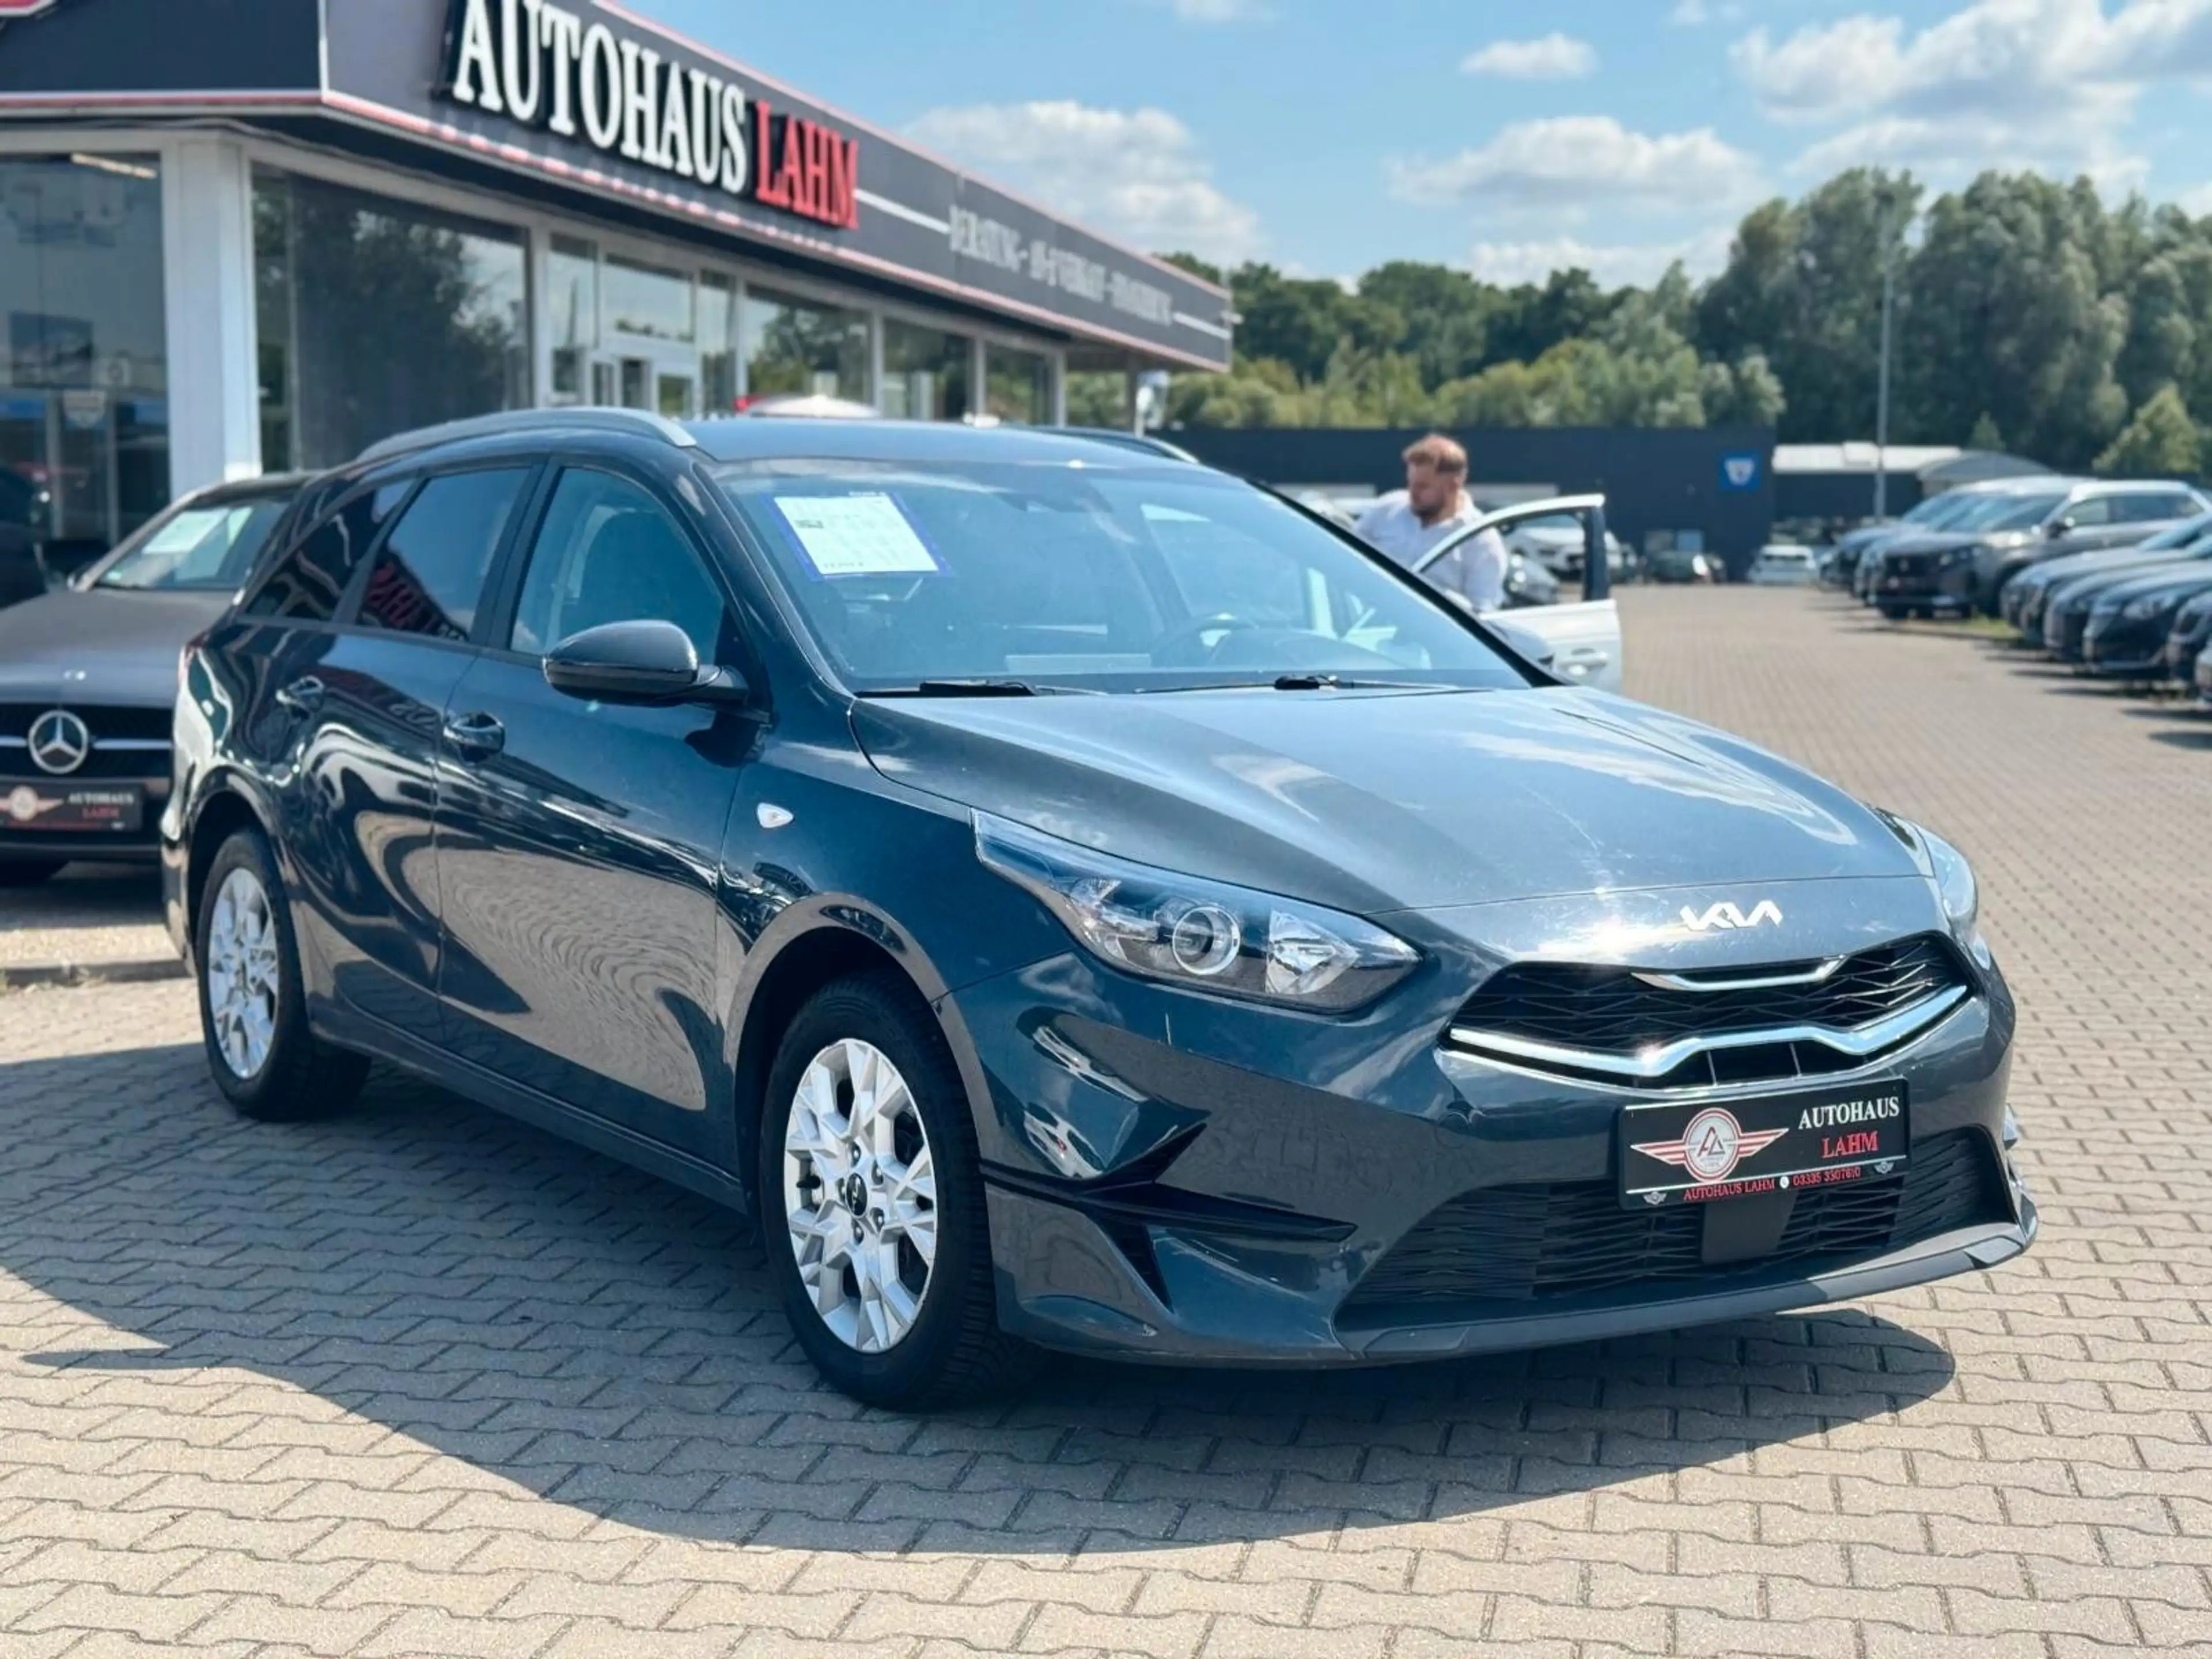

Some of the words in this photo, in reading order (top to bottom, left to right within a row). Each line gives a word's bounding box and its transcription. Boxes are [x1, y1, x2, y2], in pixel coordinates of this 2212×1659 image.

[453, 0, 747, 194] AUTOHAUS
[756, 99, 858, 229] LAHM
[1798, 1096, 1900, 1130] AUTOHAUS
[1821, 1131, 1878, 1159] LAHM
[1683, 1181, 1742, 1201] AUTOHAUS
[1744, 1178, 1775, 1193] LAHM
